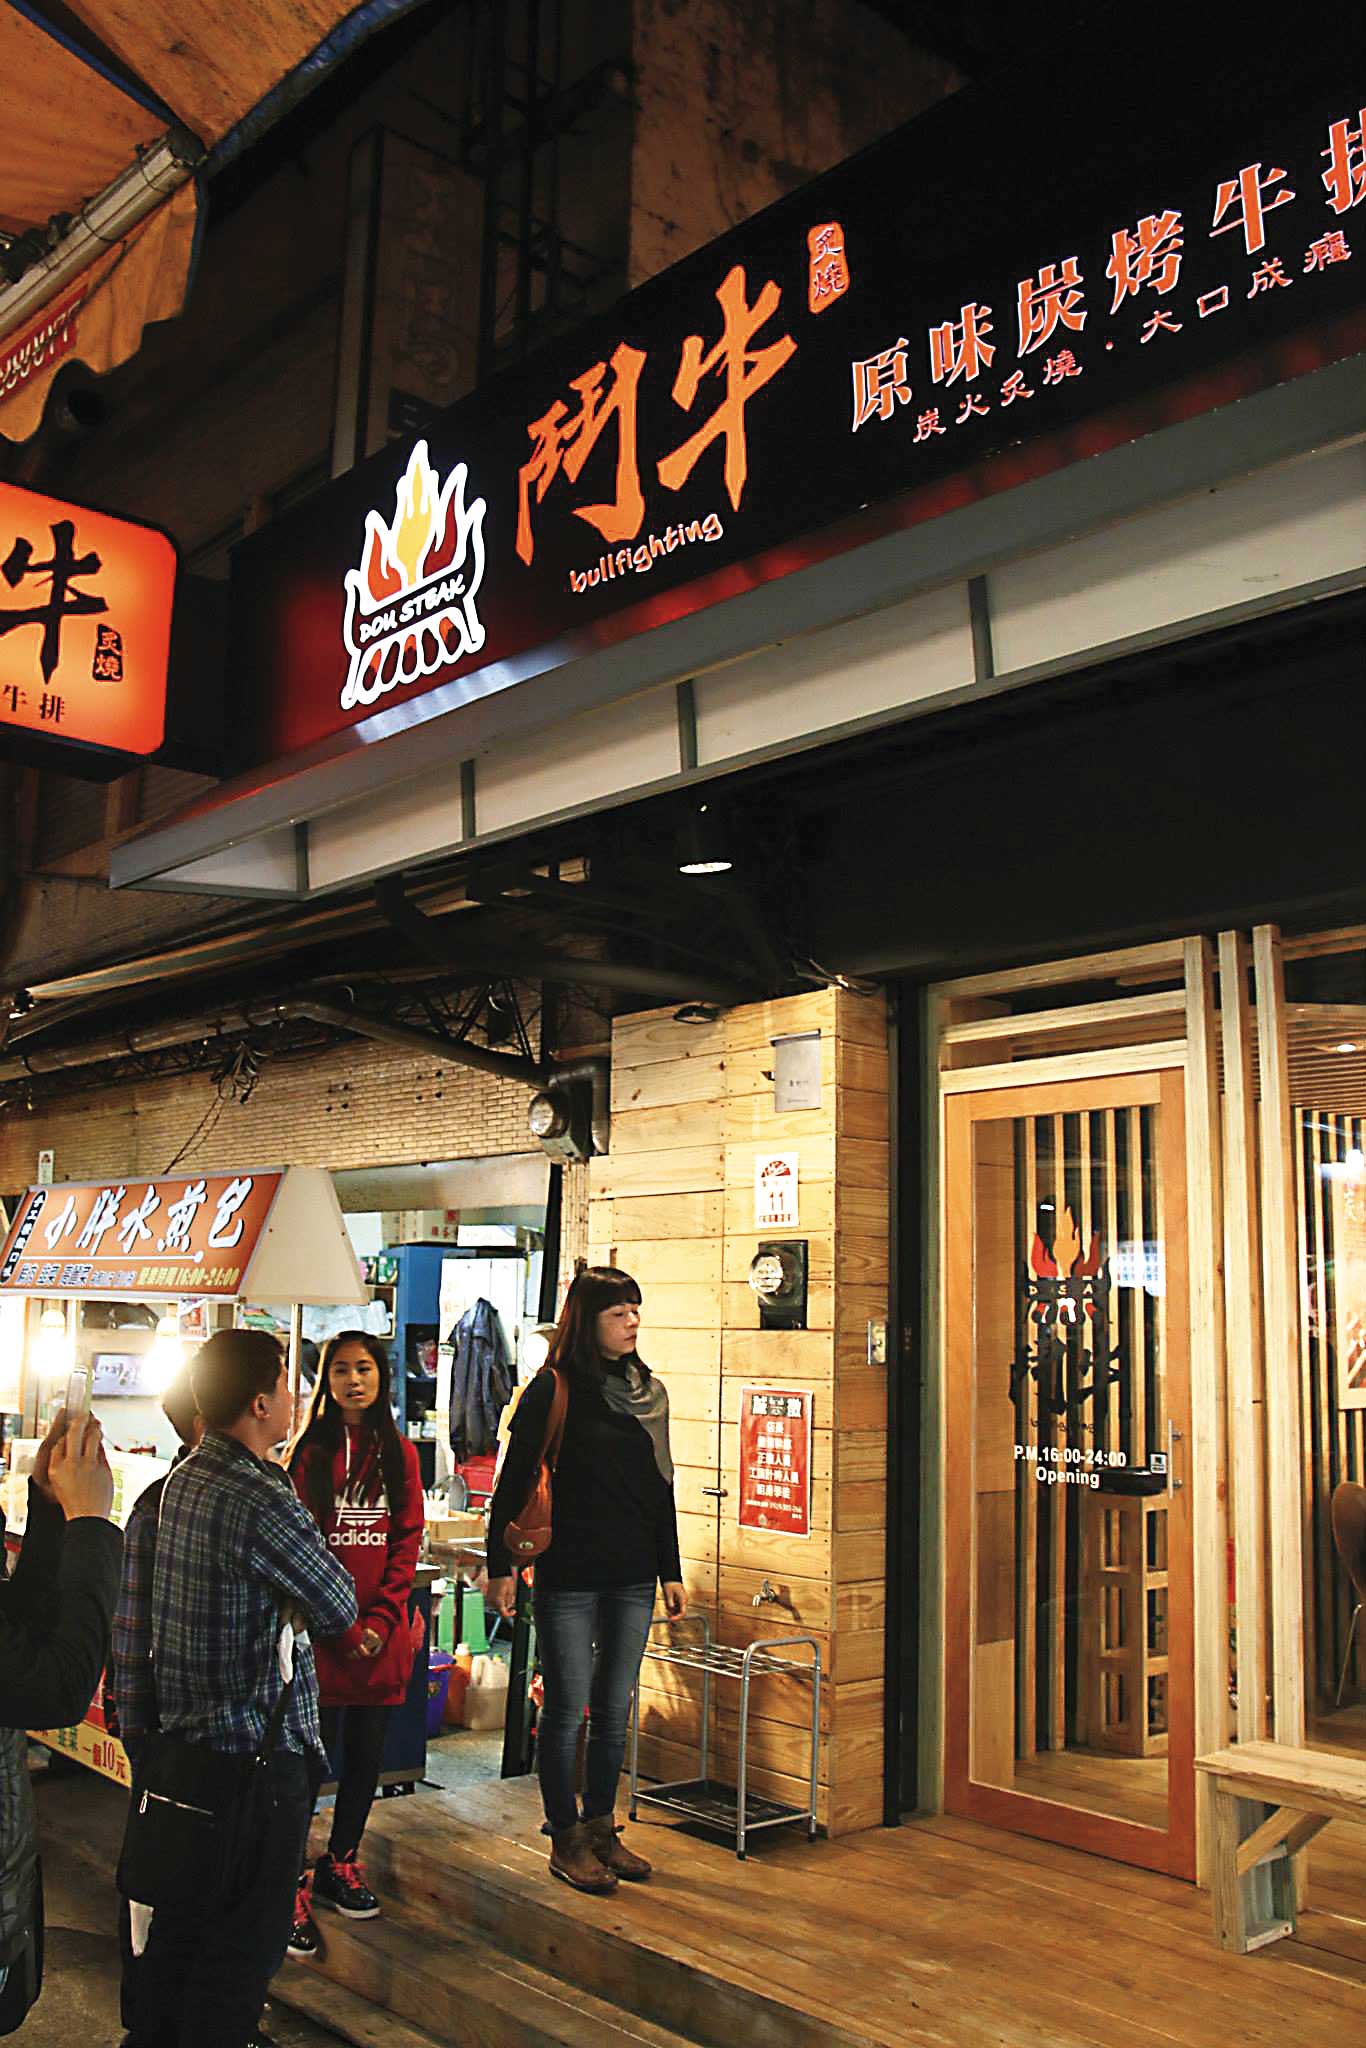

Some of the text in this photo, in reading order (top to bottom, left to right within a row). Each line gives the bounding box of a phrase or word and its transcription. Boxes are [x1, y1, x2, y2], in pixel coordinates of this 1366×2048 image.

[811, 225, 846, 302] 炙燒
[515, 264, 799, 567] 鬥牛
[568, 512, 723, 593] bullfighting
[0, 519, 109, 686] 牛
[359, 572, 467, 643] DOU STEAK
[94, 630, 121, 680] 炙燒
[3, 684, 65, 723] 牛排
[44, 1177, 254, 1257] 小胖水煎包
[769, 1191, 784, 1211] 11
[1013, 1444, 1127, 1467] P.M.16:00-24:00
[1035, 1466, 1100, 1489] Opening
[328, 1528, 388, 1547] adidas
